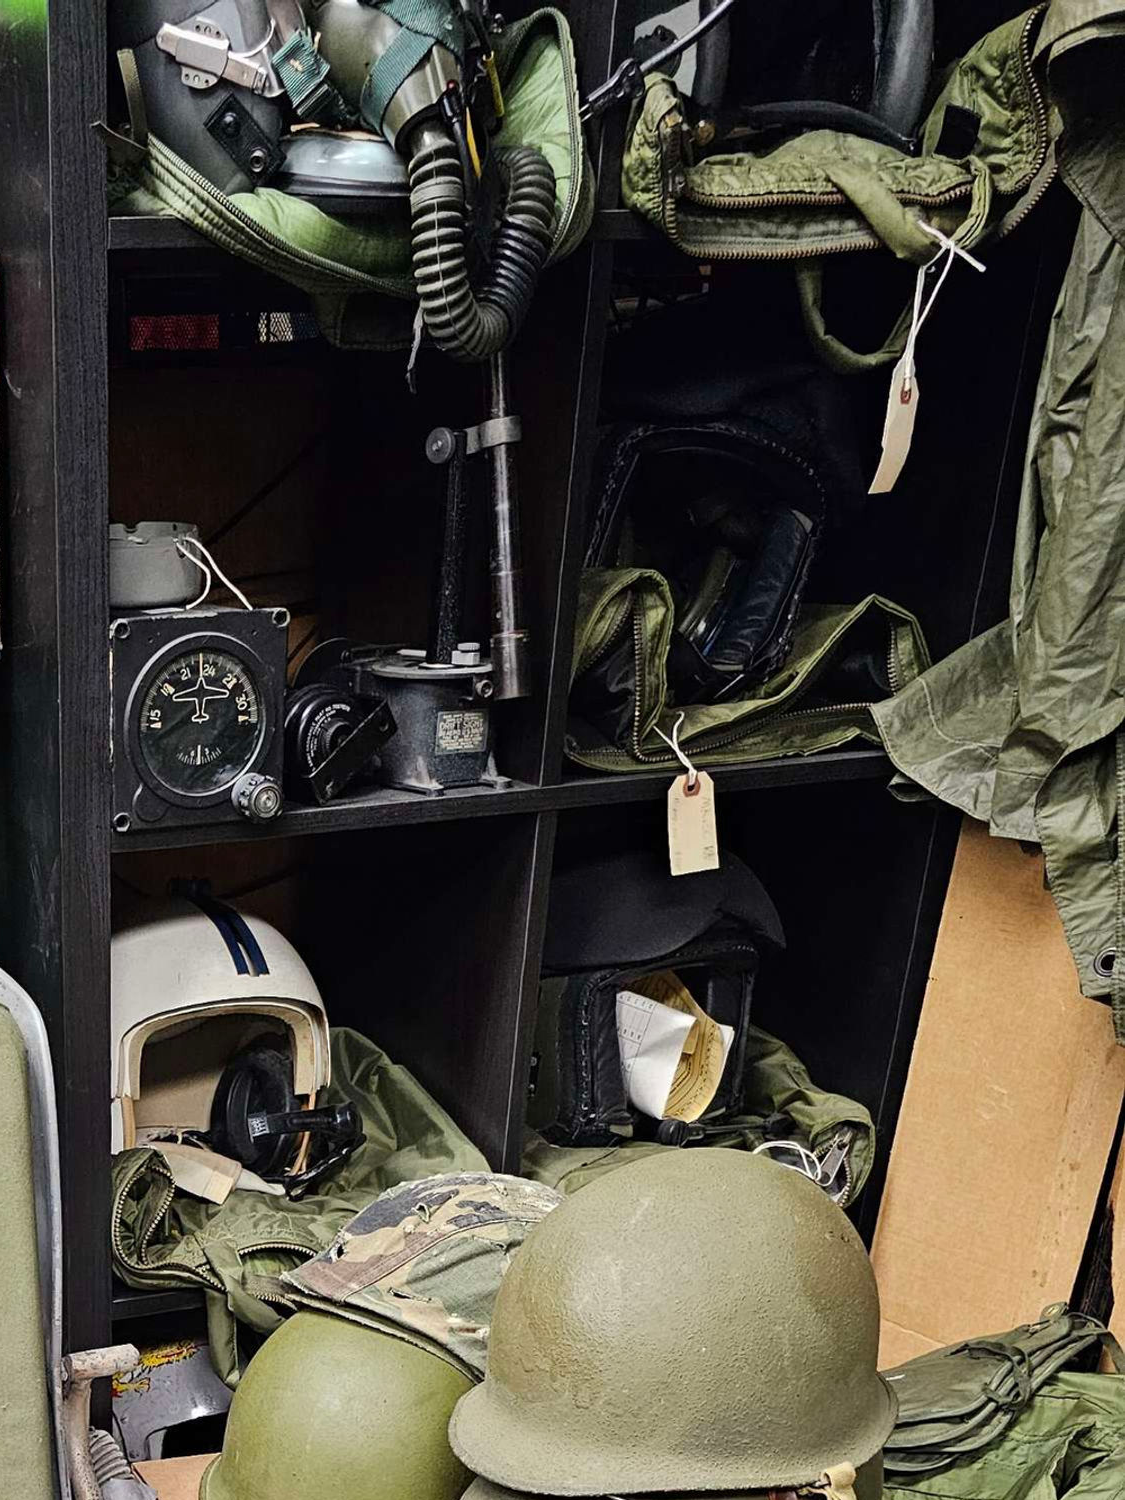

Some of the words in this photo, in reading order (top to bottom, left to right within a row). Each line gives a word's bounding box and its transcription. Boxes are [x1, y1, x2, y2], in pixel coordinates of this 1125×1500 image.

[180, 667, 191, 680] 21
[203, 664, 216, 677] 24
[235, 693, 248, 710] 30
[150, 709, 161, 721] 15
